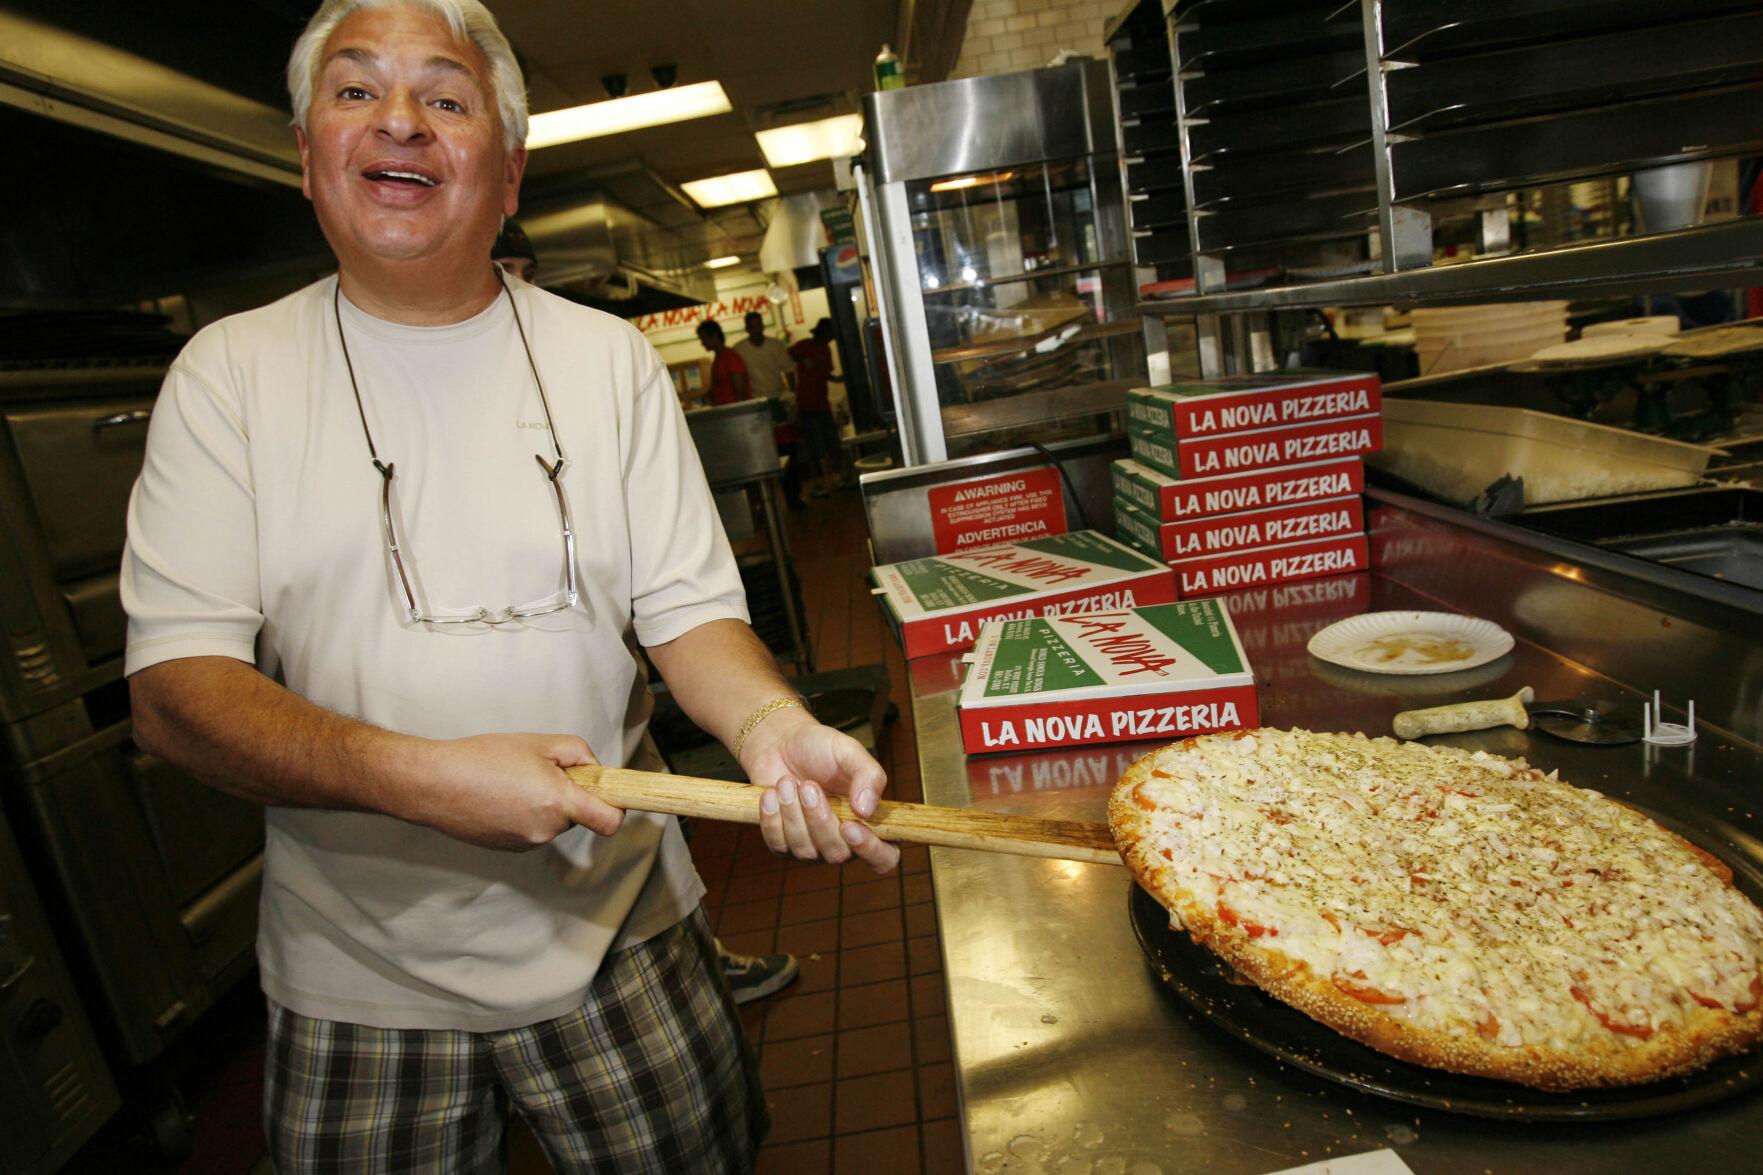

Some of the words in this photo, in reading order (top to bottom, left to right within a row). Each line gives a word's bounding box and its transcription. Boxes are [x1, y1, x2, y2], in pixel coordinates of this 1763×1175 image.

[1190, 411, 1217, 433] LA
[1221, 403, 1277, 428] NOVA
[1282, 390, 1369, 420] PIZZERIA
[1194, 451, 1220, 473] LA
[1225, 443, 1280, 468] NOVA
[1285, 429, 1372, 459] PIZZERIA
[964, 481, 1026, 499] WARNING
[1174, 494, 1200, 516] LA
[1206, 486, 1261, 511] NOVA
[1266, 473, 1351, 502] PIZZERIA
[957, 520, 1047, 545] ADVERTENCIA
[1175, 533, 1202, 554] LA
[1207, 525, 1261, 550] NOVA
[1266, 511, 1351, 539] PIZZERIA
[1182, 572, 1208, 592] LA
[1212, 563, 1266, 587] NOVA
[1271, 549, 1356, 578] PIZZERIA
[944, 621, 974, 645] LA
[1058, 613, 1130, 638] LA
[1039, 628, 1086, 677] PIZZERIA
[1089, 633, 1177, 676] NOVA
[982, 720, 1018, 747] LA
[1025, 714, 1105, 743] NOVA
[1111, 702, 1241, 736] PIZZERIA
